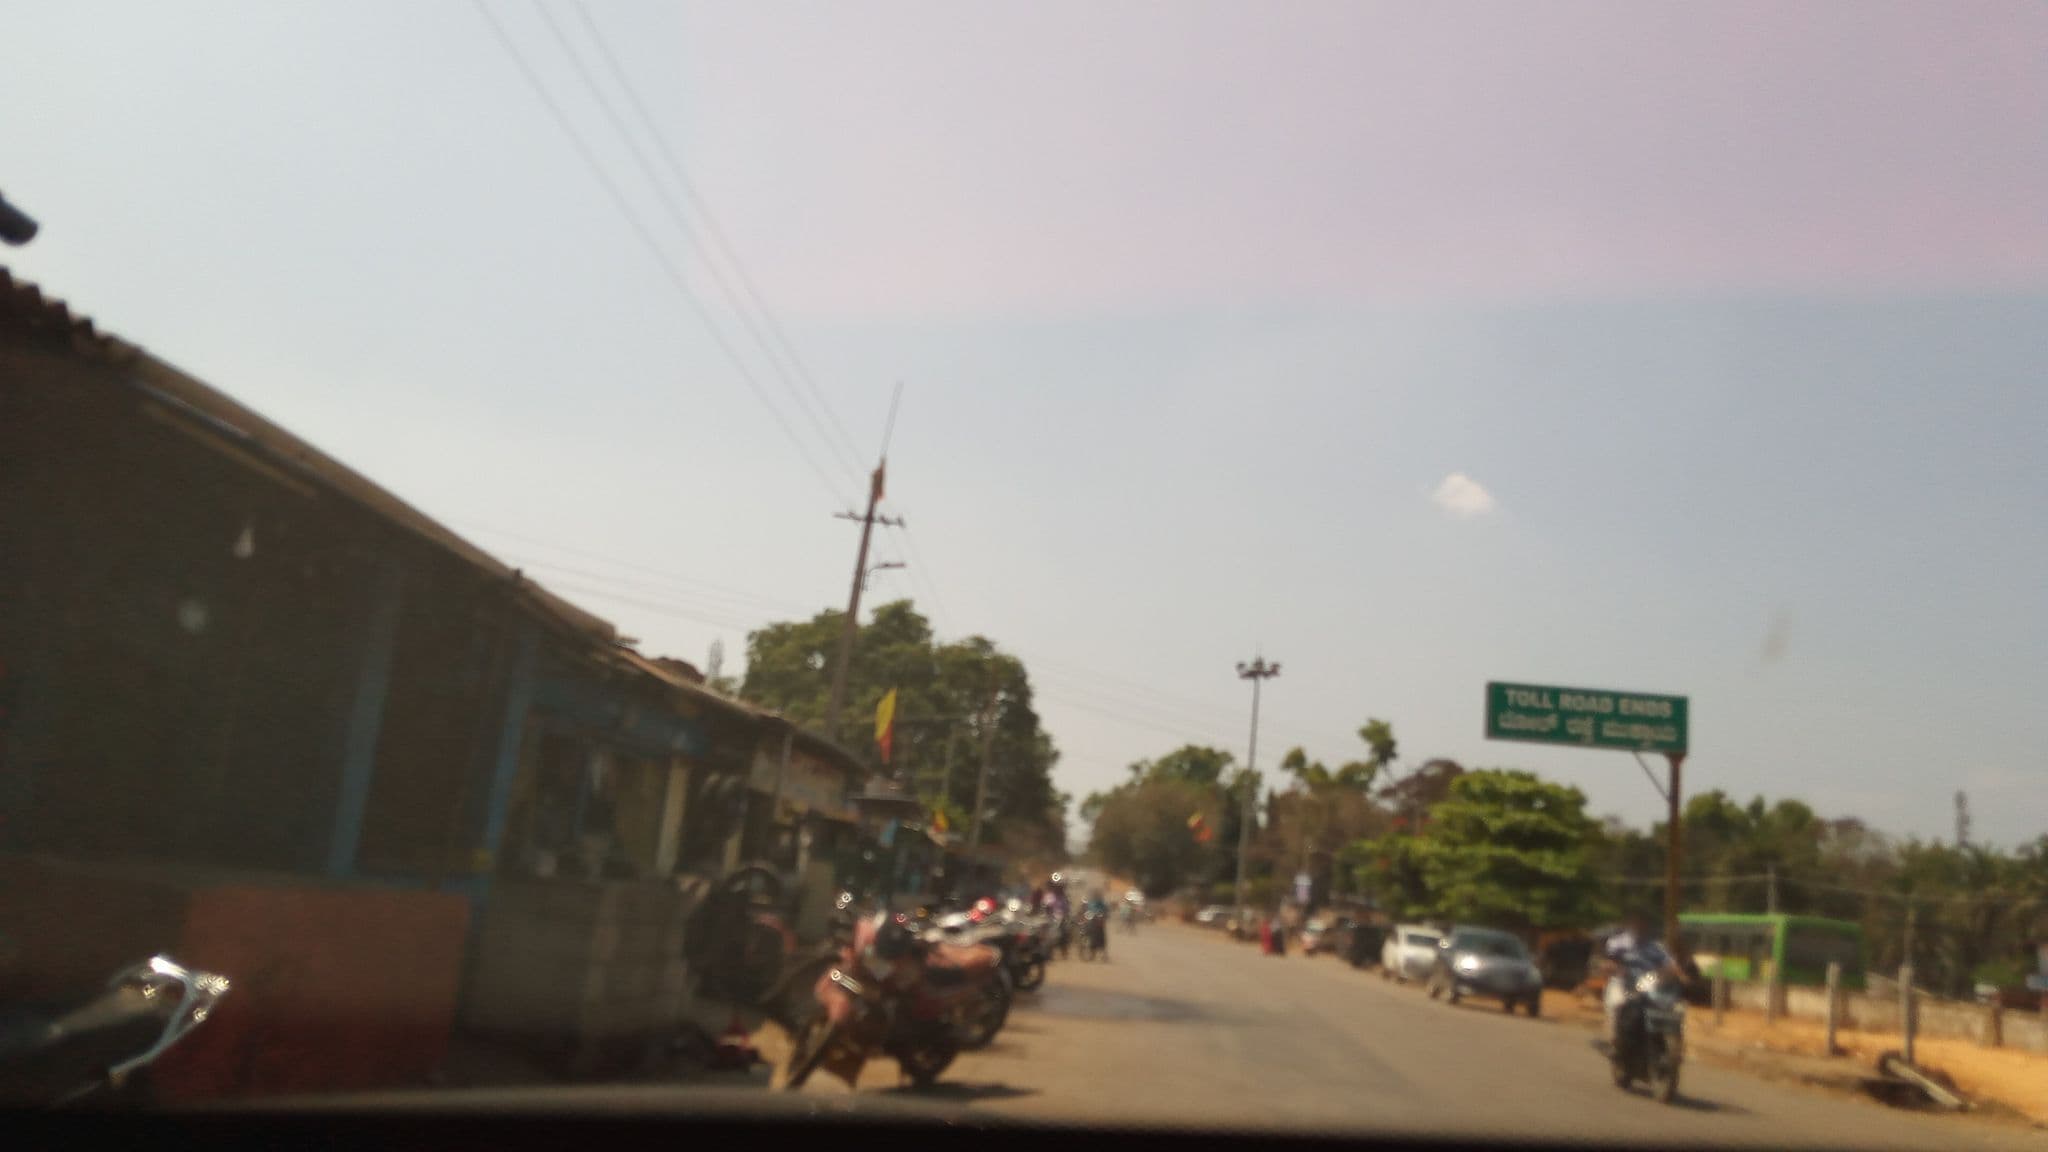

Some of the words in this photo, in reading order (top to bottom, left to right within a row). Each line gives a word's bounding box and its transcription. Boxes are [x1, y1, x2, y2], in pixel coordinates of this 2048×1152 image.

[1505, 689, 1553, 709] TOLL
[1559, 694, 1614, 713] ROAD
[1619, 699, 1672, 718] ENDS
